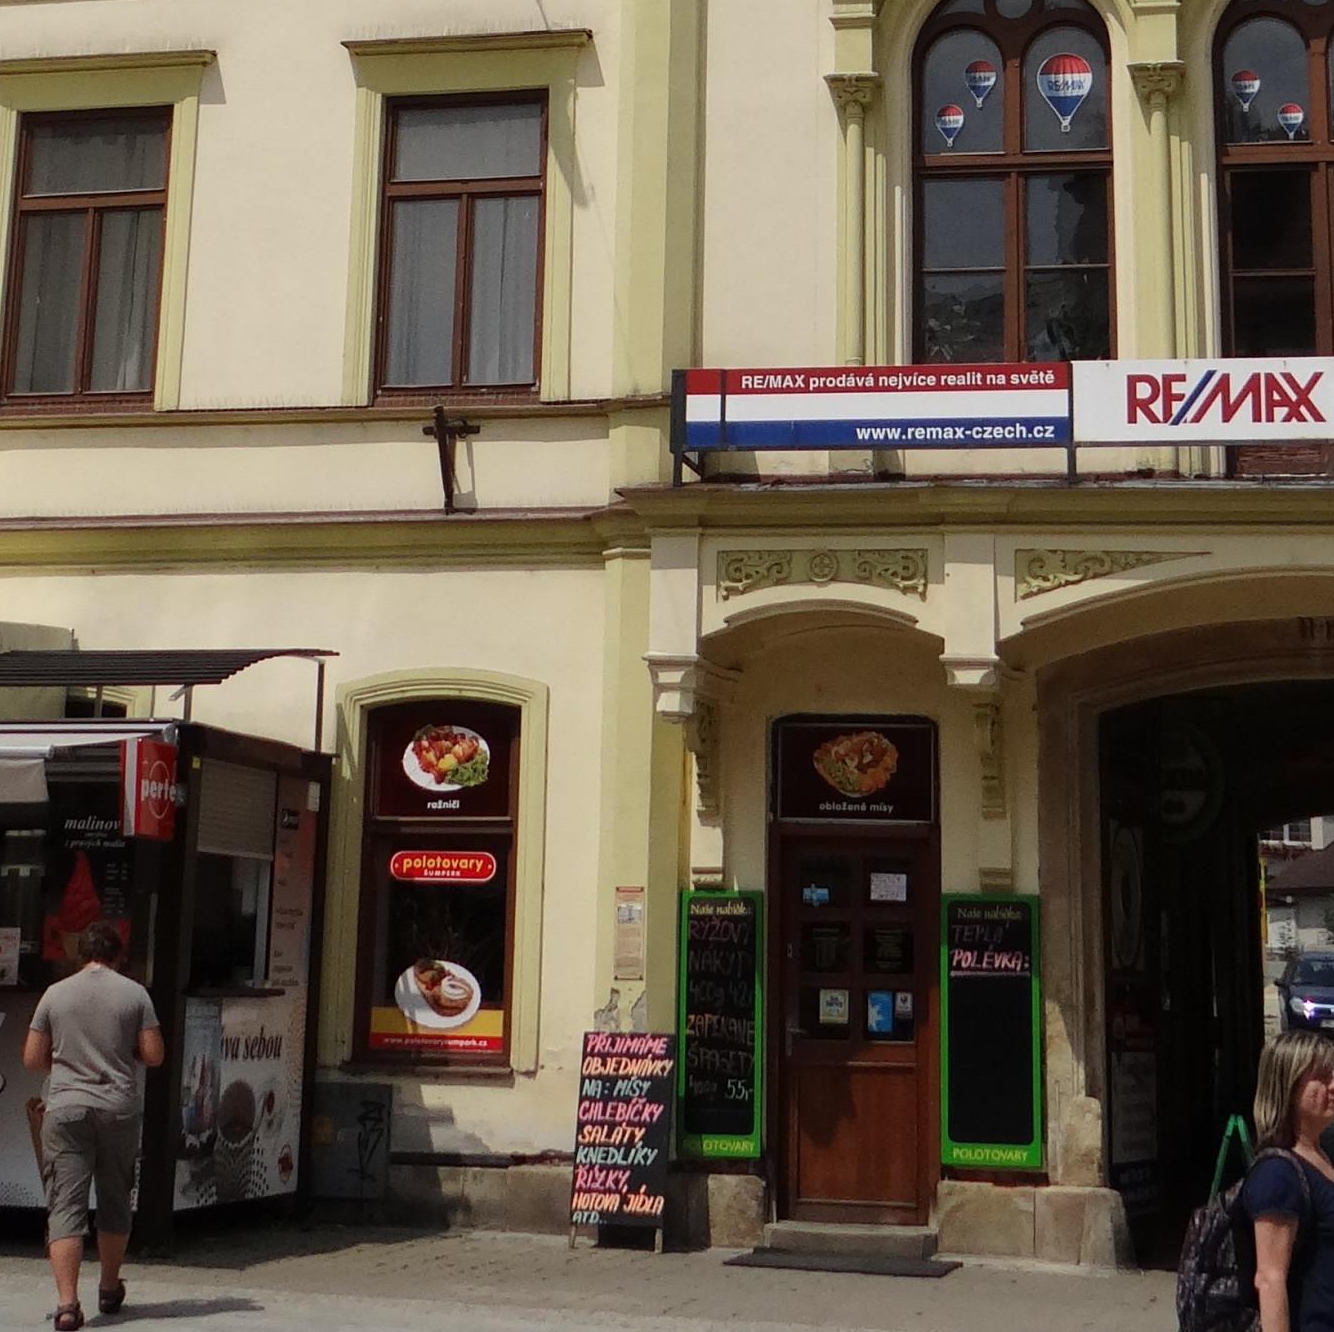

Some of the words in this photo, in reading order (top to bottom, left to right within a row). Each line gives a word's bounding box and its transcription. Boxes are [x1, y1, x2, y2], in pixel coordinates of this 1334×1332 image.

[741, 375, 805, 389] RE/MAX
[809, 371, 875, 391] prodává
[878, 370, 937, 389] nejvíce
[940, 371, 982, 387] realit
[986, 374, 1007, 386] na
[1010, 370, 1055, 385] světě
[1126, 369, 1326, 426] RE/MAX
[855, 422, 1055, 441] www.remax-czech.cz
[869, 801, 895, 815] mísy
[402, 854, 484, 874] polotovary
[243, 1025, 284, 1061] sebou
[582, 1054, 674, 1078] OBJEDNÁVKY
[613, 1076, 652, 1098] MÍSY
[578, 1097, 665, 1123] CHLEBÍČKY
[576, 1141, 659, 1166] KNEDLÍKY
[952, 1147, 1028, 1162] POLOTOVARY
